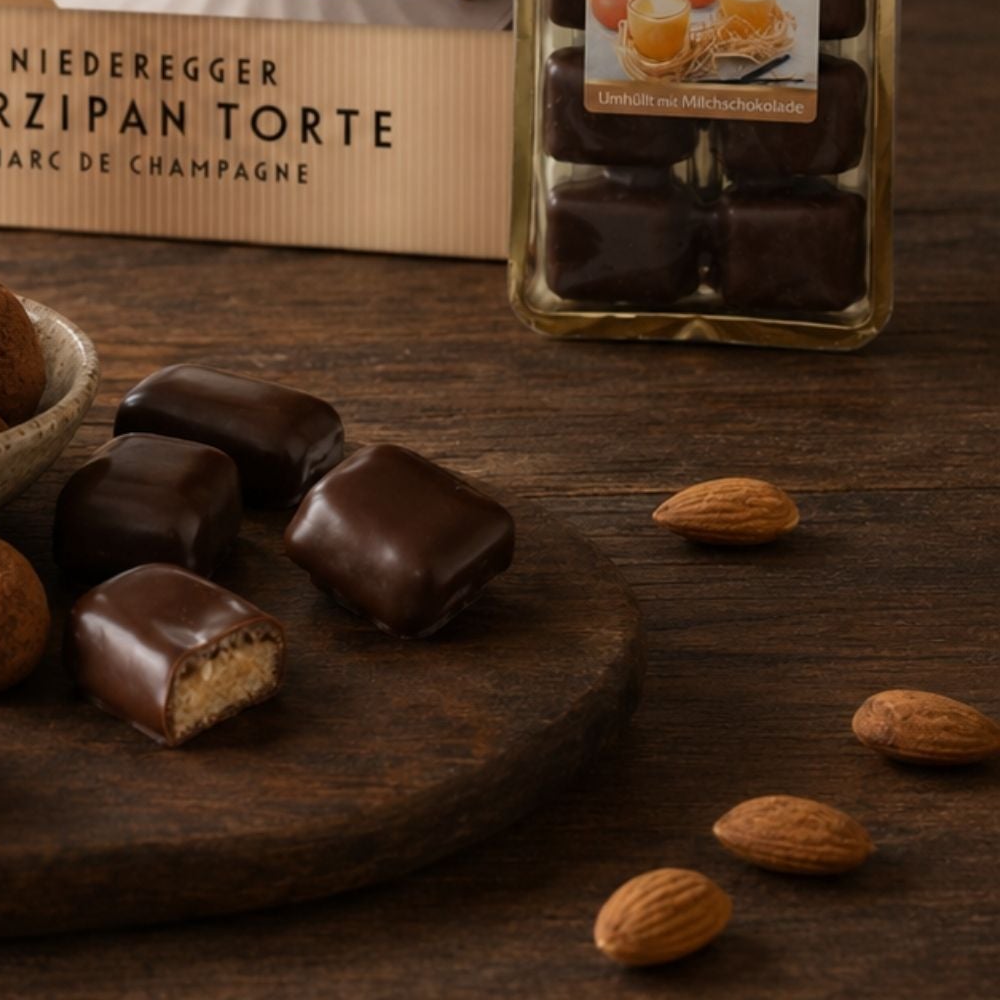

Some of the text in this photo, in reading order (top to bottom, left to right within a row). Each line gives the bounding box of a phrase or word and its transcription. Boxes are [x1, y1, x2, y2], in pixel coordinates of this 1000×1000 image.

[10, 48, 278, 86] NIEDEREGGER
[656, 96, 678, 108] mit
[682, 95, 805, 114] Milchschokolade
[217, 102, 393, 148] TORTE
[79, 151, 111, 173] DE
[130, 154, 309, 184] CHAMPAGNE
